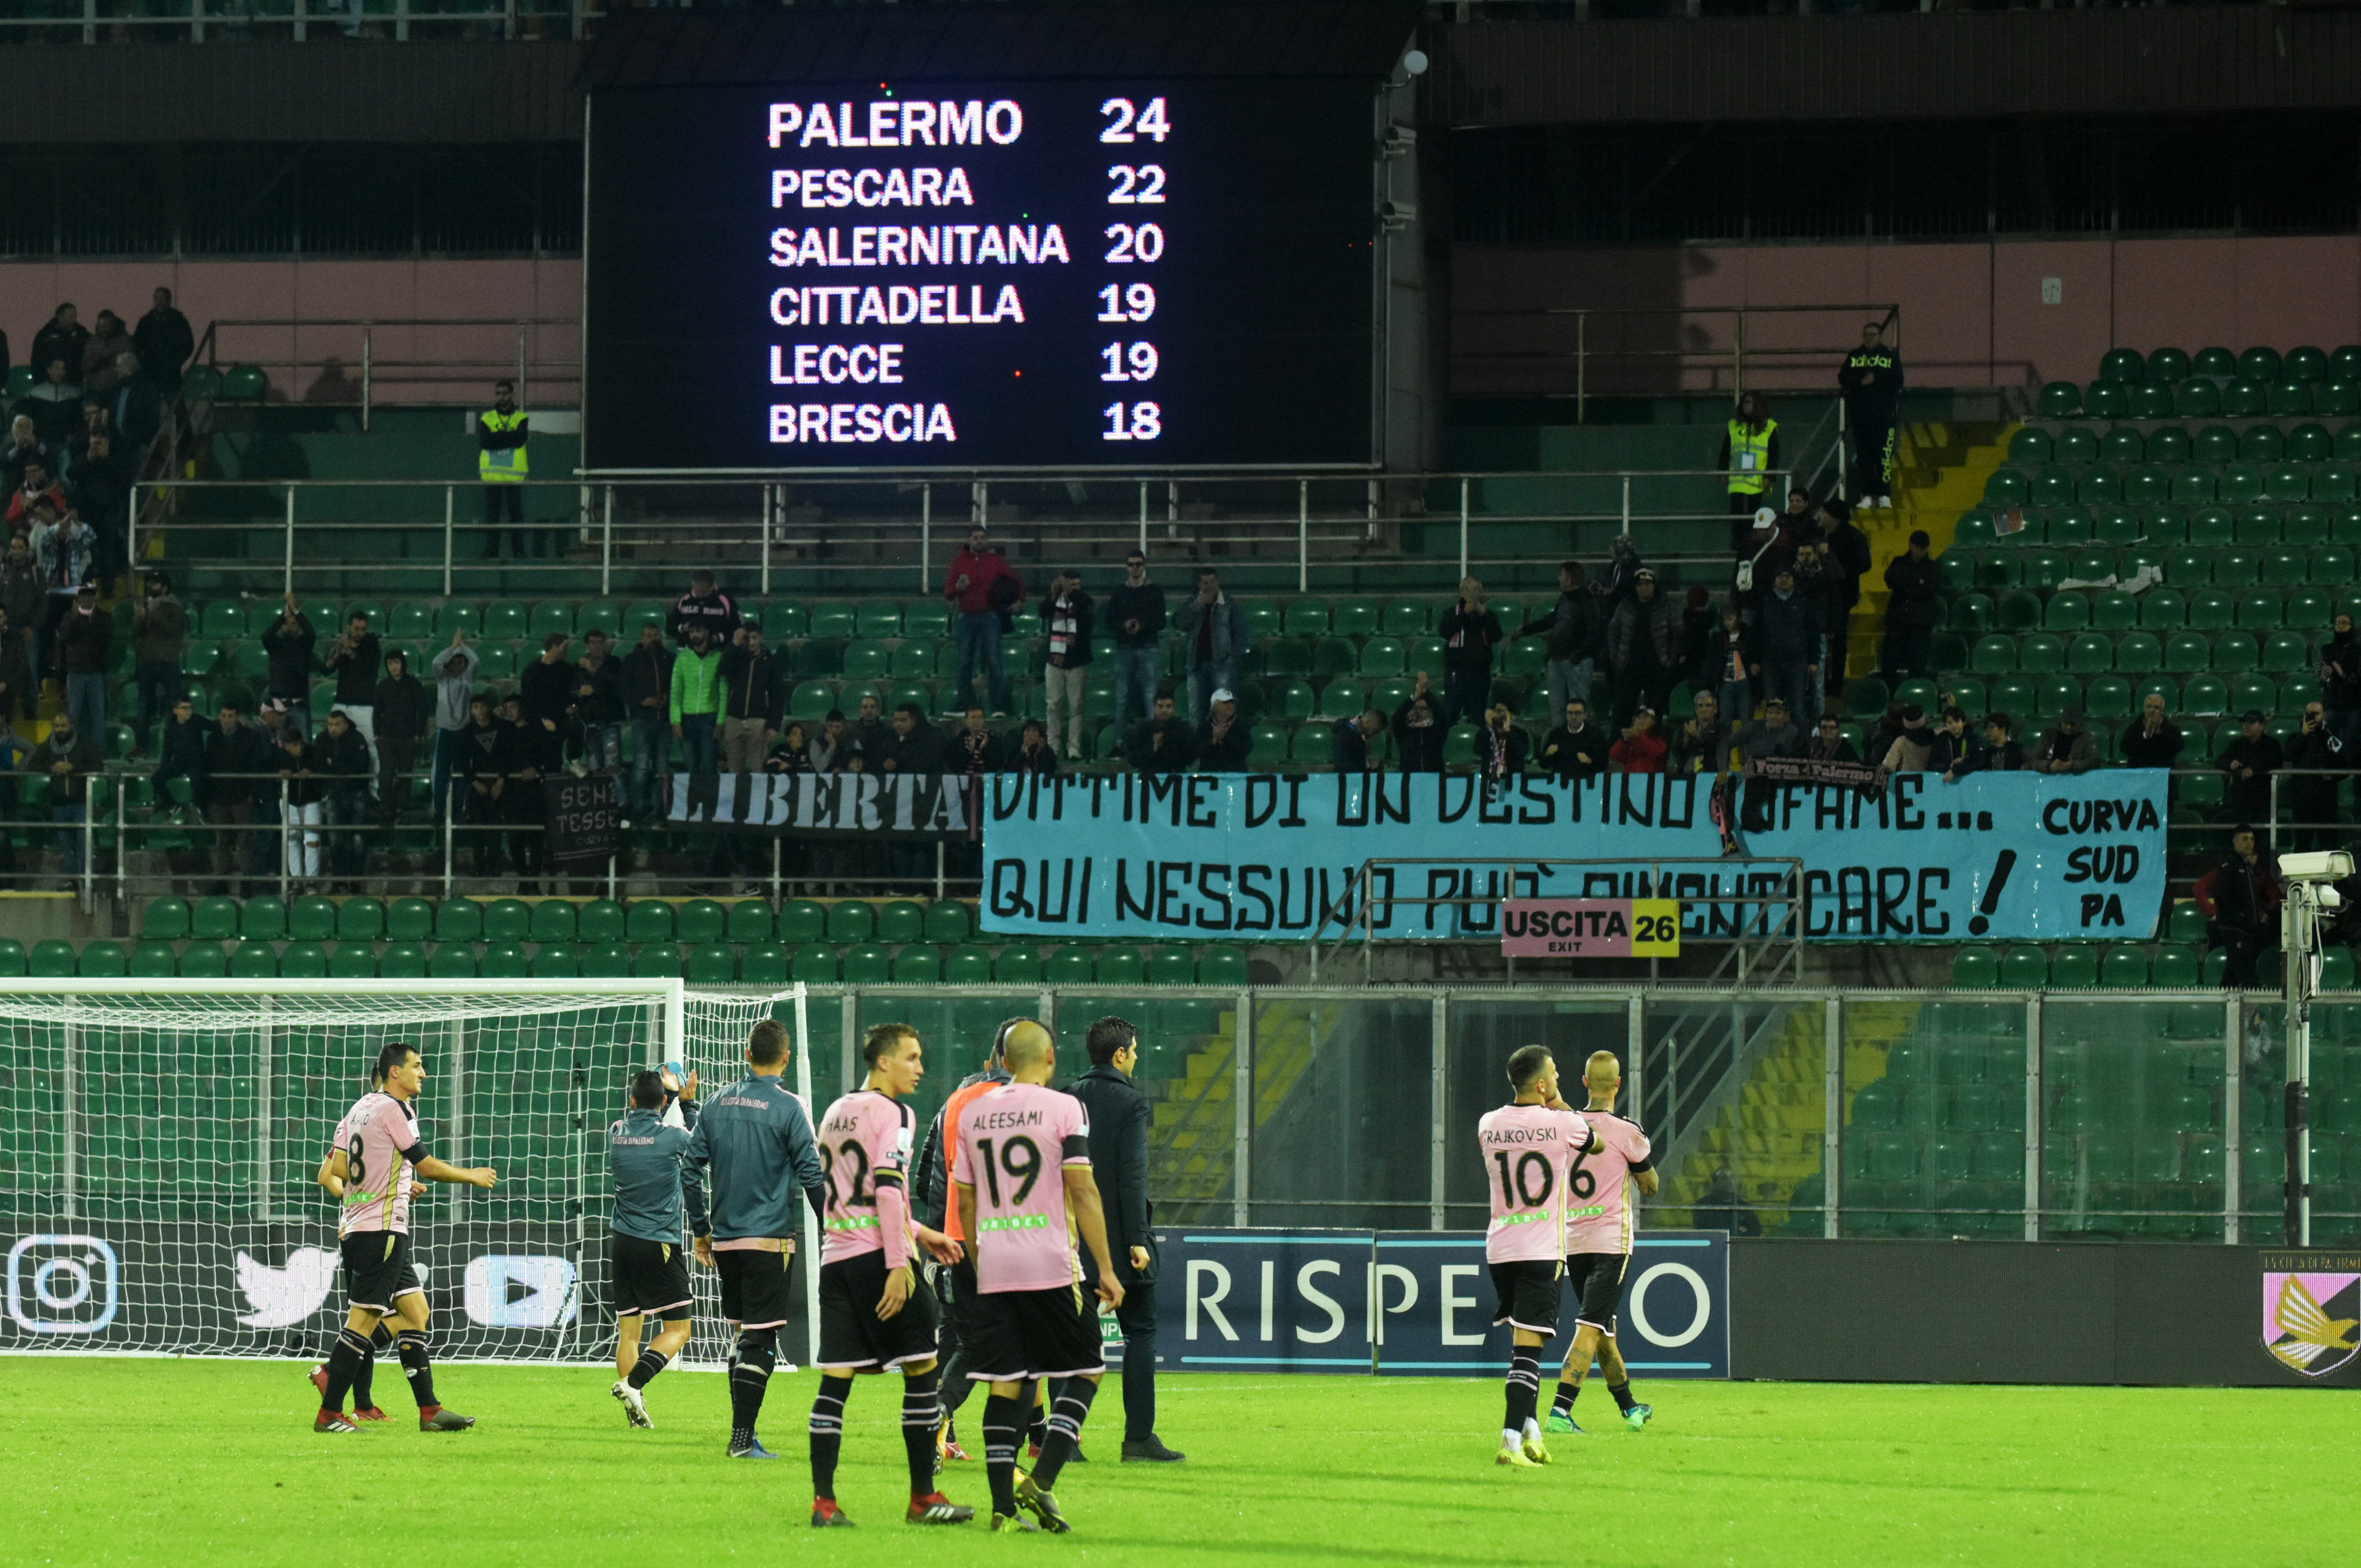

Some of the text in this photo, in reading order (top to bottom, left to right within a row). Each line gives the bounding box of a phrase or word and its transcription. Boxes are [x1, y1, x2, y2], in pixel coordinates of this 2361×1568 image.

[768, 98, 1170, 147] PALERMO 24
[772, 164, 1166, 208] PESCARA 22
[770, 223, 1164, 267] SALERNITANA 20
[770, 283, 1156, 325] CITTADELLA 19
[770, 341, 1158, 384] LECCE 19
[770, 401, 1161, 443] BRESCIA 18
[1883, 428, 1895, 483] adidas
[1756, 759, 1800, 774] Forza
[1811, 764, 1874, 780] Palermo
[1245, 775, 1308, 828] DI
[1337, 772, 1411, 826] UN
[1439, 772, 1697, 828] DESTINO
[2042, 799, 2159, 835] CURVA
[2063, 845, 2139, 883] SUD
[991, 857, 1092, 923] QUI
[1116, 858, 1395, 931] NESSUNO
[2081, 893, 2125, 927] PA
[1504, 911, 1675, 942] USCITA 26
[1548, 942, 1582, 952] EXIT
[746, 1098, 769, 1110] PALERMO
[973, 1110, 1043, 1130] ALEESAMI
[348, 1132, 366, 1186] 8
[632, 1136, 655, 1145] PALERMO
[977, 1134, 1042, 1208] 19
[1494, 1150, 1554, 1210] 10
[1570, 1152, 1596, 1200] 6
[980, 1213, 1048, 1232] UNIBET
[1185, 1260, 1710, 1347] RISPEO
